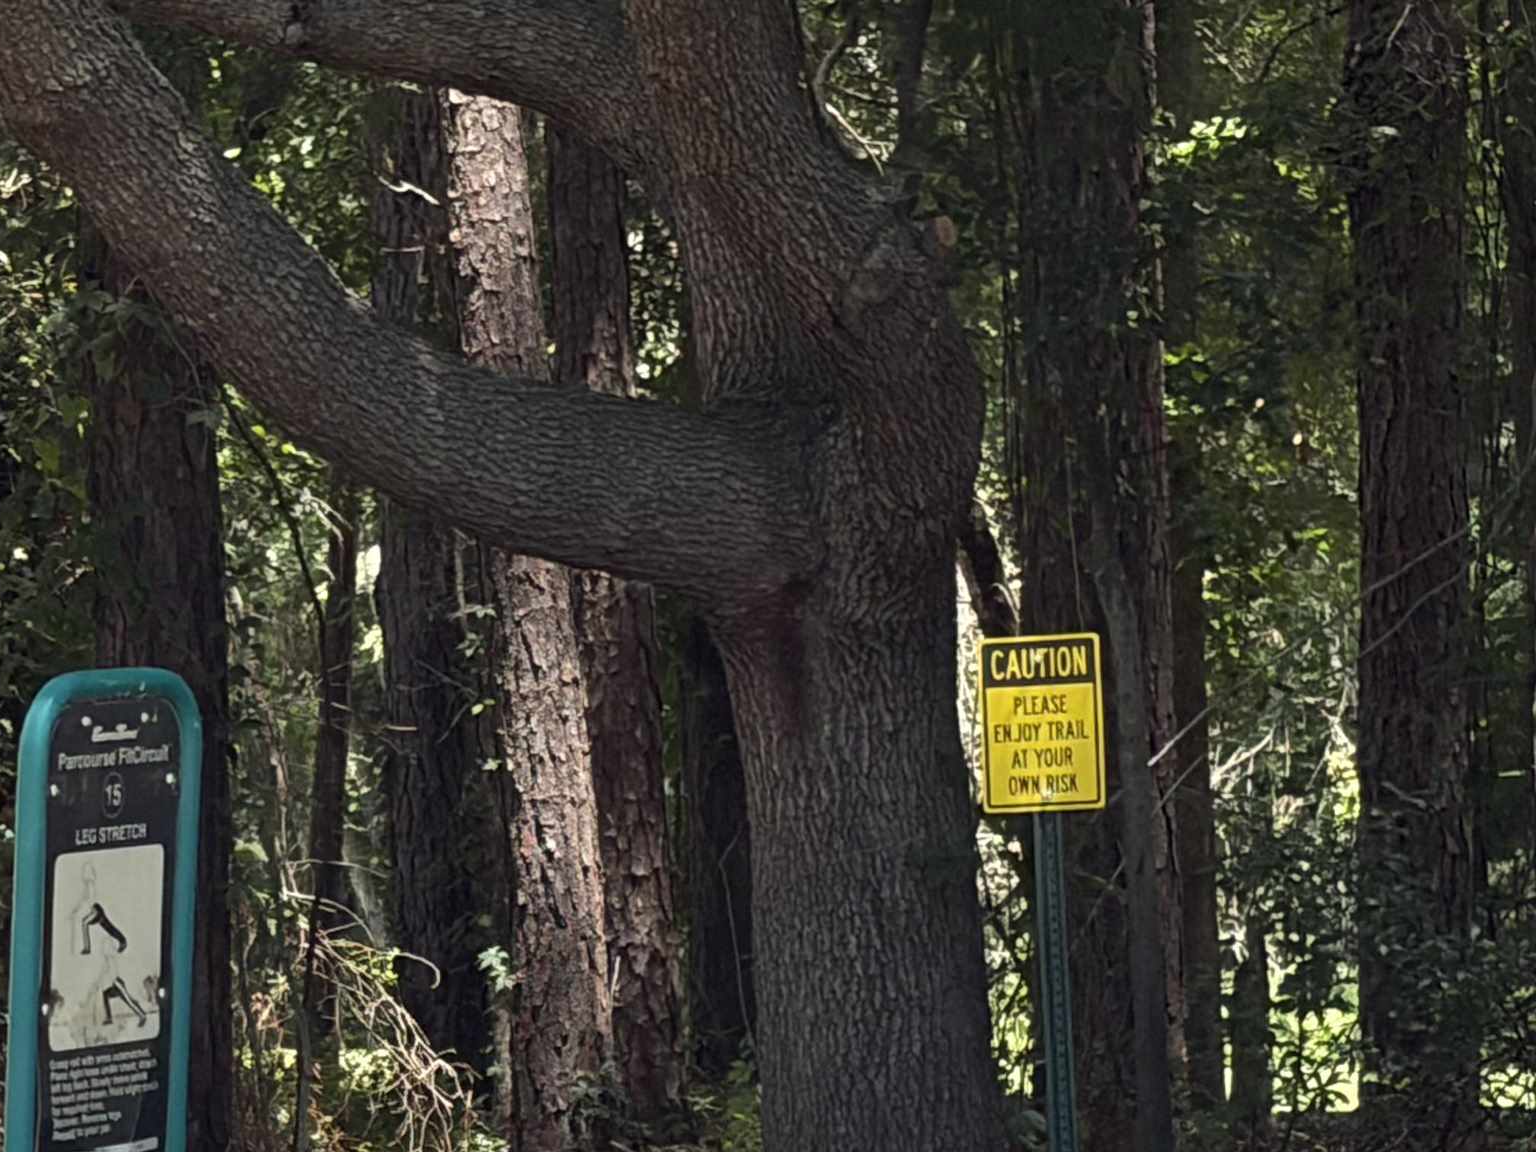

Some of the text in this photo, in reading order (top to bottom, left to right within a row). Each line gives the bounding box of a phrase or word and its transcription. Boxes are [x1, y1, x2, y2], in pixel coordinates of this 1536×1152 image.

[990, 645, 1088, 680] CAUTION
[1013, 695, 1068, 716] PLEASE
[993, 719, 1090, 743] ENJOY TRAIL
[58, 752, 115, 770] Parcourse
[1011, 747, 1074, 769] AT YOUR
[105, 783, 122, 807] 15
[1008, 773, 1079, 796] OWN RISK
[75, 823, 148, 846] LEG STRETCH
